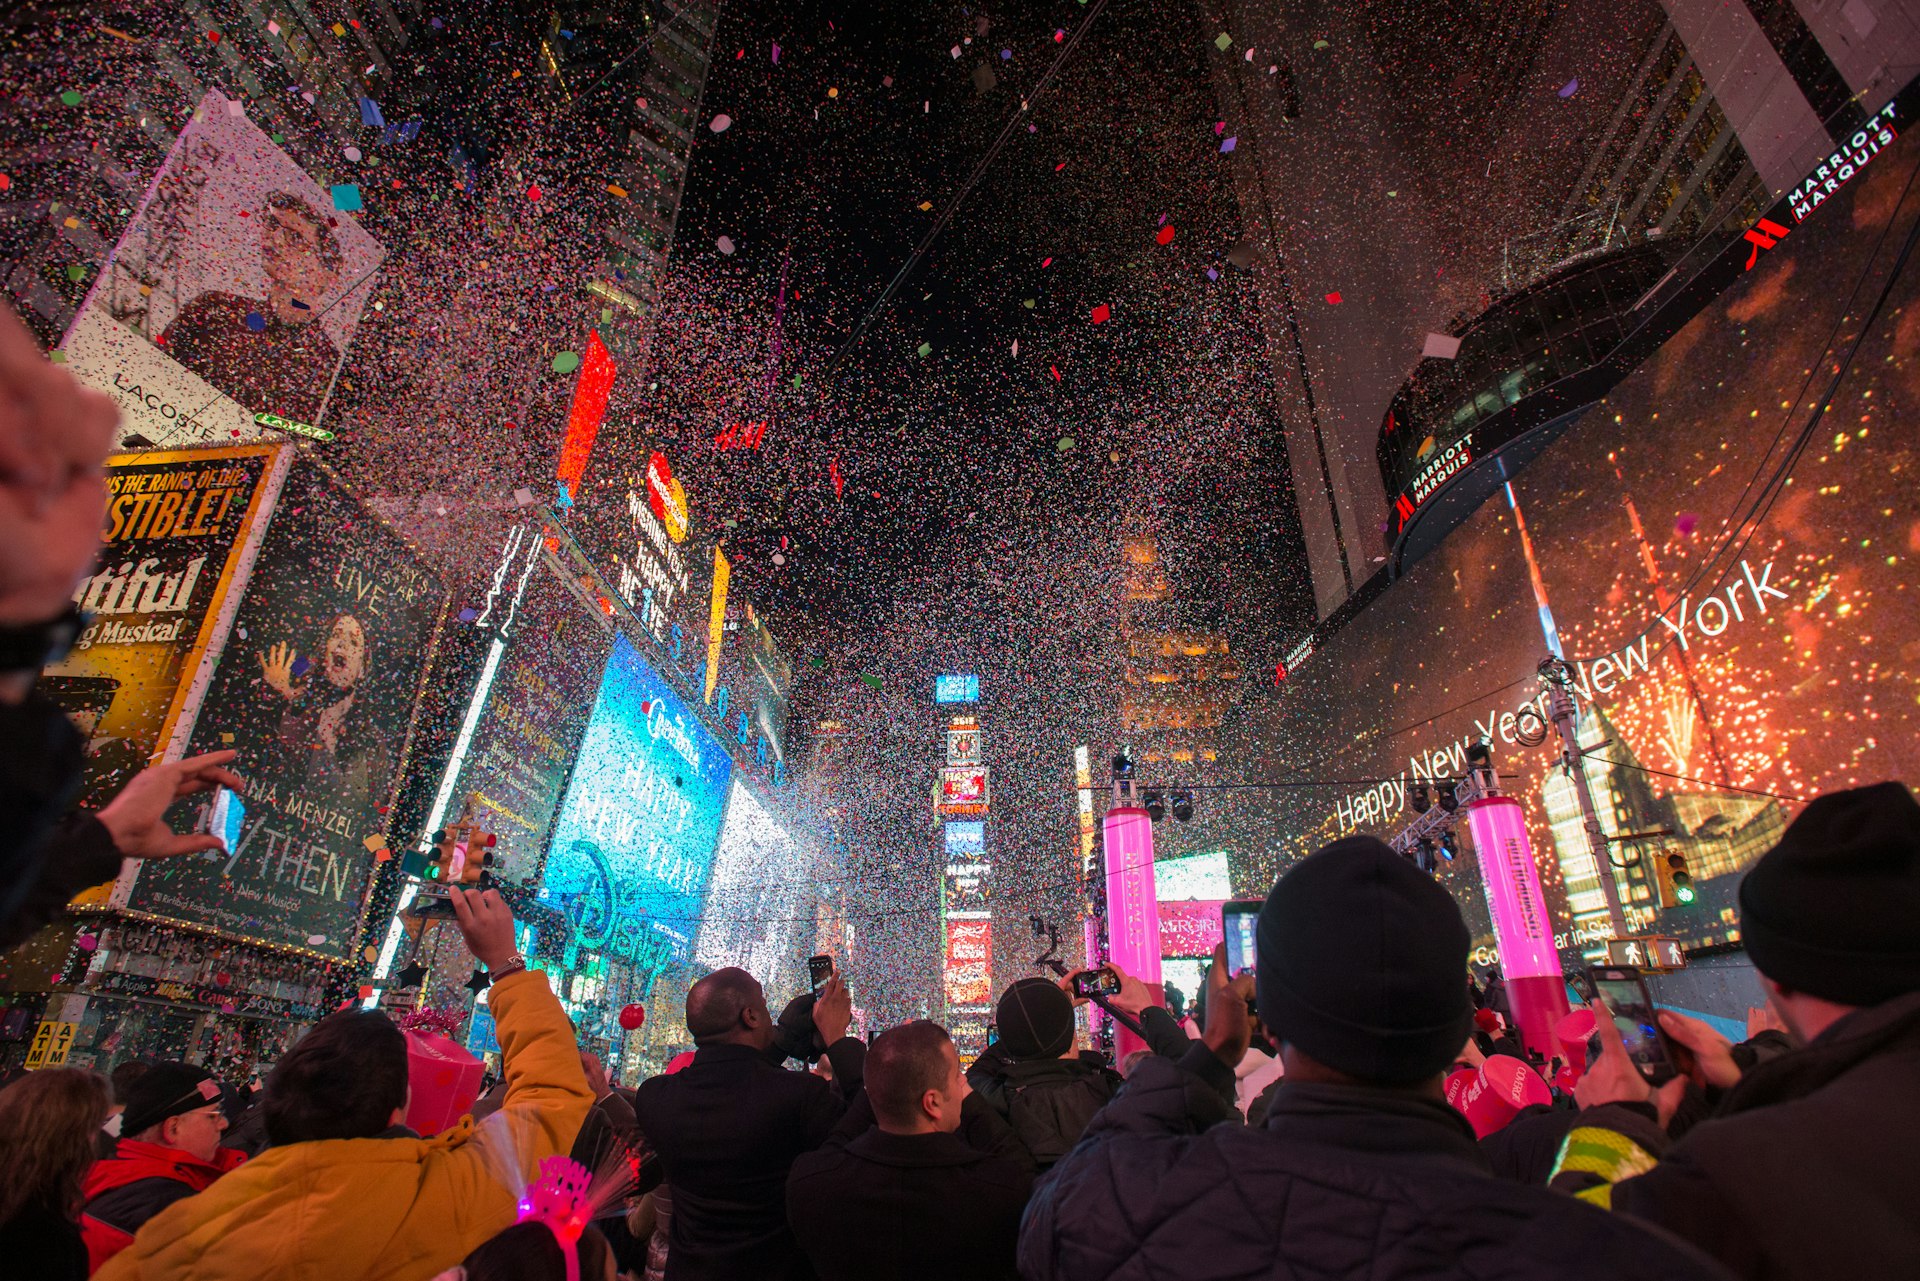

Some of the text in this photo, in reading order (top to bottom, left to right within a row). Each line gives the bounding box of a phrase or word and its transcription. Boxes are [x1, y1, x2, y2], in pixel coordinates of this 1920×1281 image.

[1788, 102, 1895, 206] MARRIOTT
[1795, 130, 1893, 219] MARQUIS
[113, 373, 215, 441] LACOSTE
[121, 474, 147, 493] THE
[148, 471, 197, 492] RANKS
[196, 470, 216, 489] OF
[214, 468, 244, 487] THE
[1412, 433, 1472, 491] MARRIOTT
[1415, 453, 1469, 503] MARQUIS
[72, 557, 207, 614] tiful
[335, 558, 385, 616] LIVE
[96, 617, 185, 645] Musical
[1286, 634, 1314, 663] MARRIOTT
[1571, 559, 1788, 701] New York
[1287, 646, 1313, 672] MARQUIS
[1337, 690, 1548, 831] Happy New Year
[284, 795, 355, 839] MENZEL
[939, 804, 990, 814] TOSHIBA
[237, 882, 263, 901] New
[1125, 852, 1144, 948] COVERGIRL
[1504, 837, 1544, 939] COSMOPOLITAN
[1159, 918, 1222, 934] VERGIRL
[1569, 925, 1587, 946] in
[121, 980, 148, 993] Apple
[249, 997, 286, 1013] SONY
[29, 1024, 51, 1062] ATM
[49, 1025, 71, 1063] ATM
